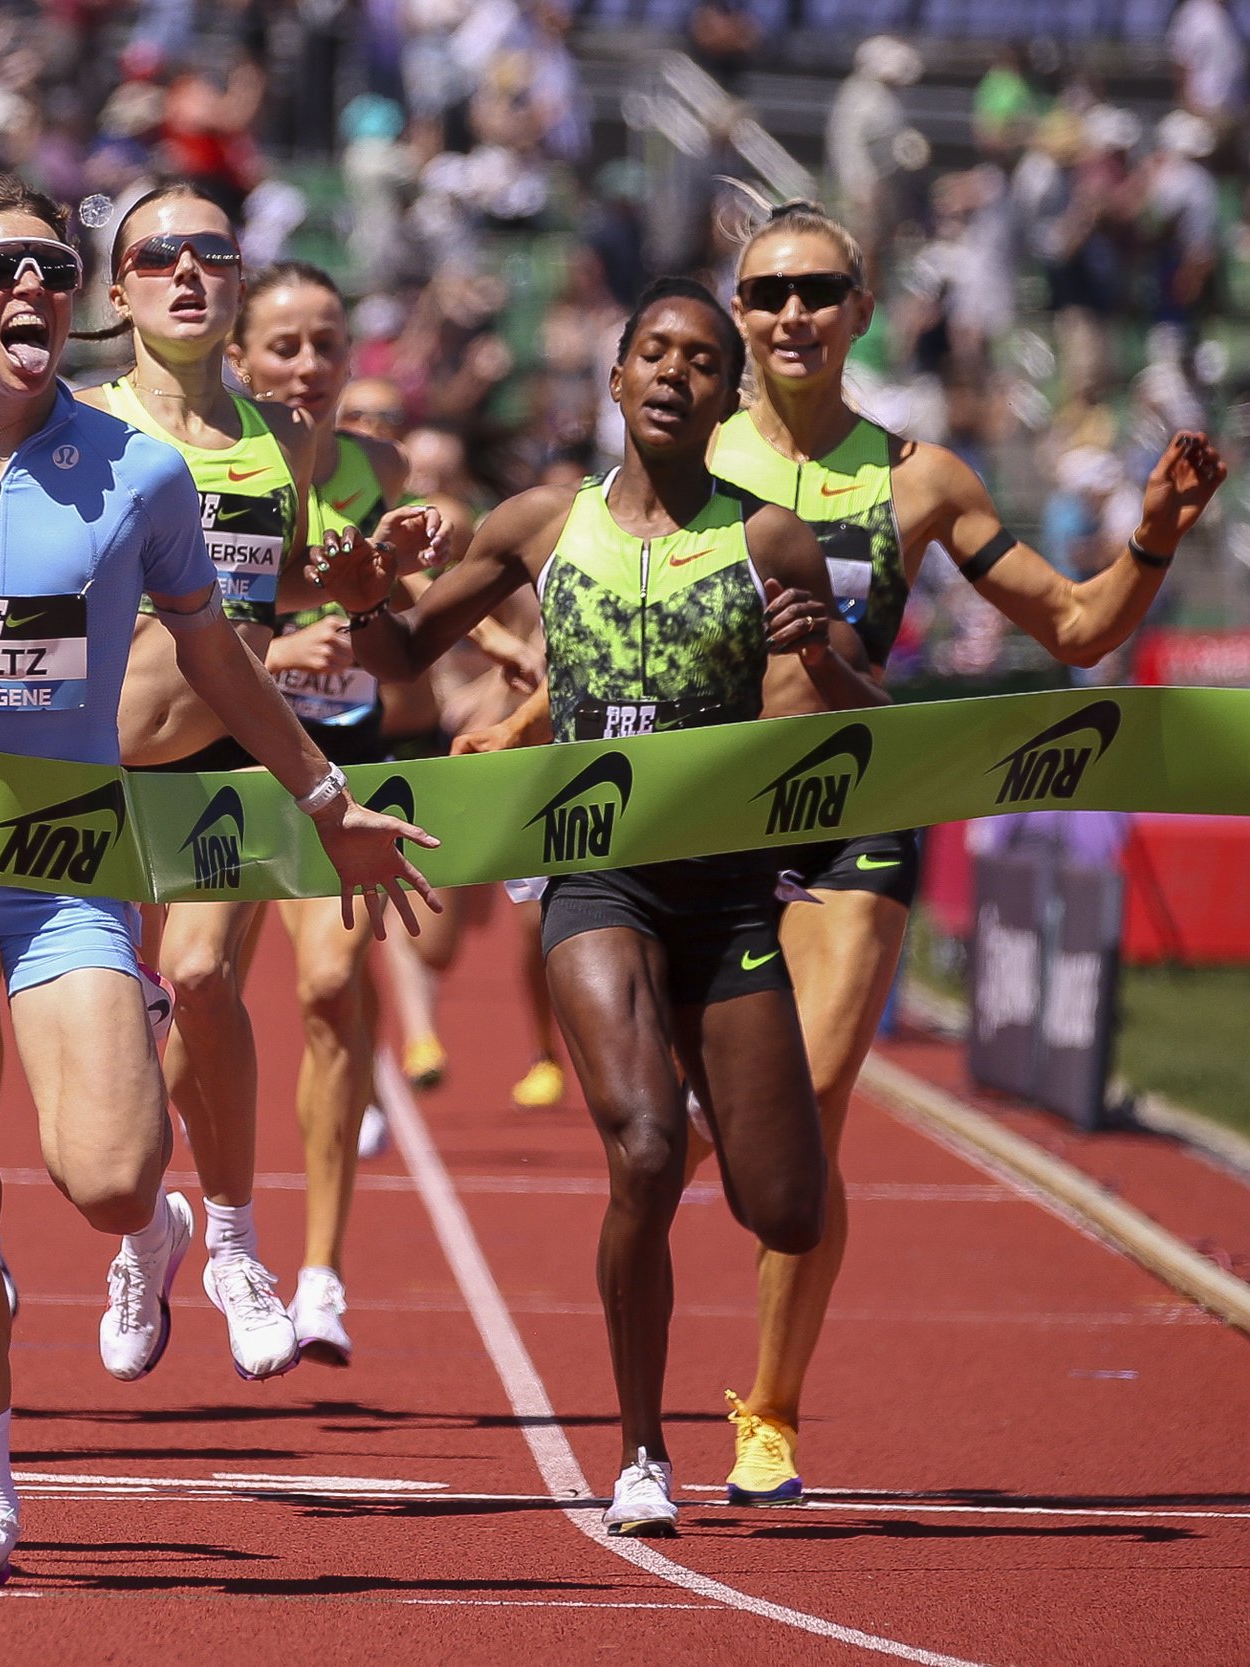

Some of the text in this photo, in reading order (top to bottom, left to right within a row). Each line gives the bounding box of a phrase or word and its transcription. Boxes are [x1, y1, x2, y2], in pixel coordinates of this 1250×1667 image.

[603, 705, 656, 738] PRE
[765, 773, 851, 836] RUN
[995, 747, 1092, 805] RUN
[543, 801, 615, 864] RUN
[193, 834, 240, 890] RUN
